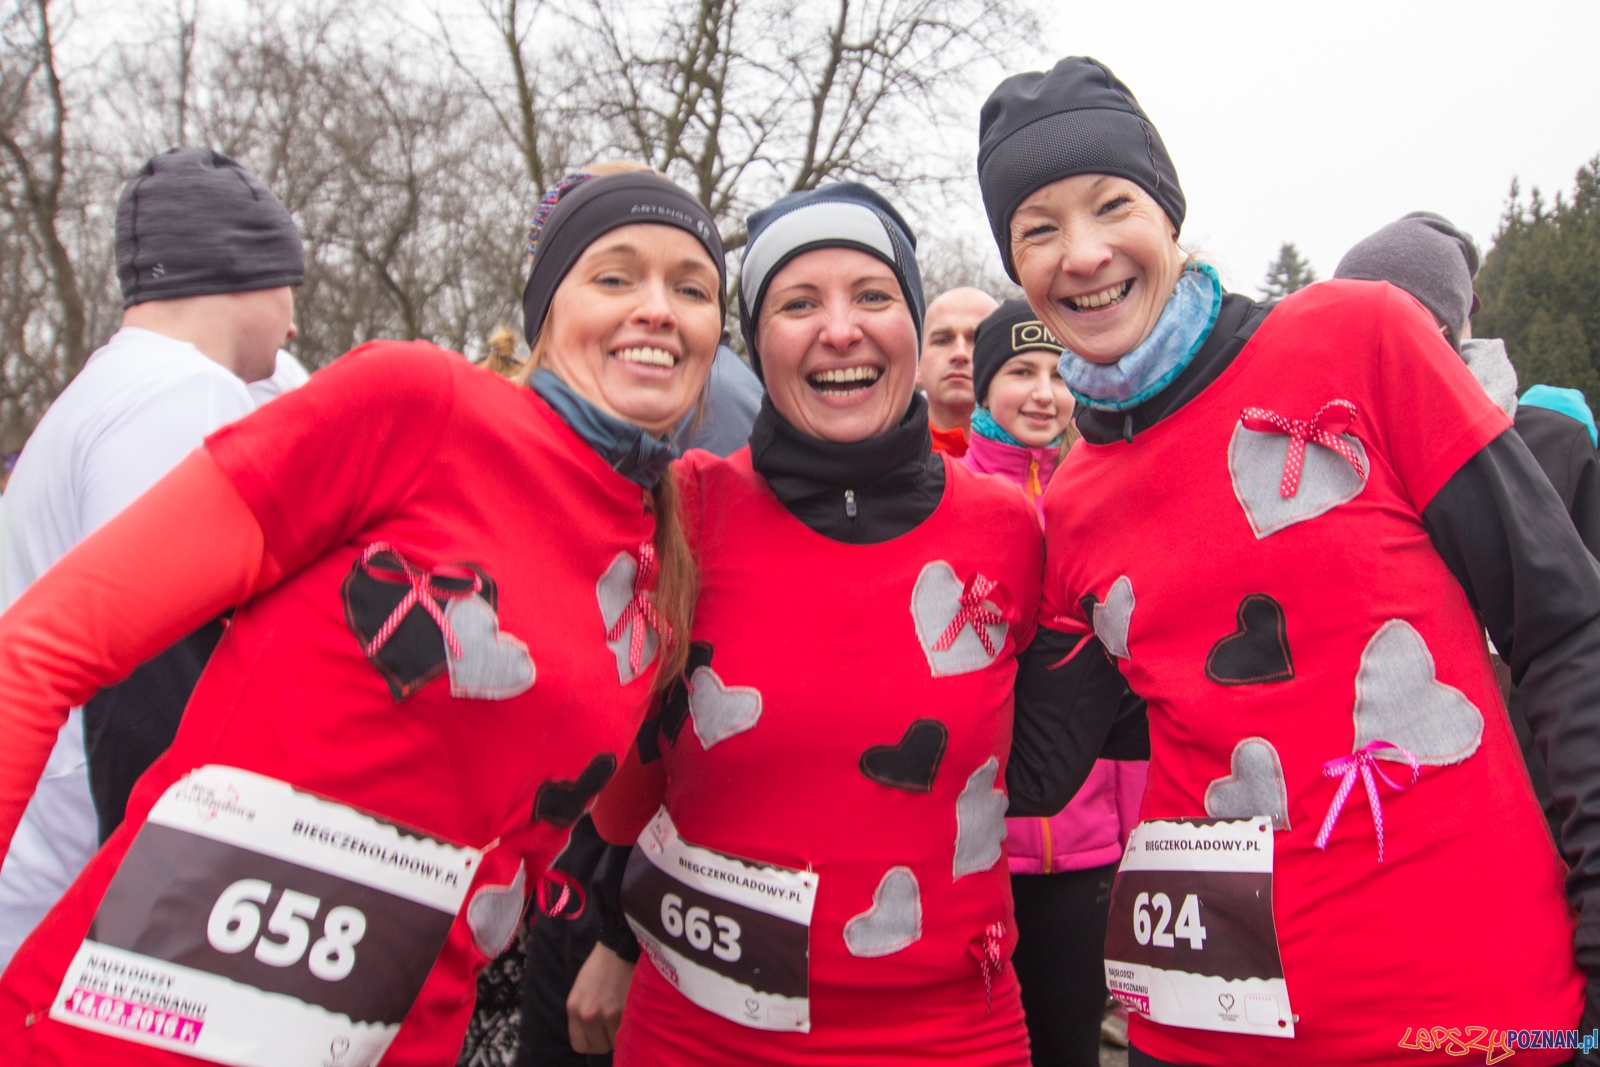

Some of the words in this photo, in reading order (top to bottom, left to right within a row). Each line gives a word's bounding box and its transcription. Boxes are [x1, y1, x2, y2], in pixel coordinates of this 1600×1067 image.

[631, 204, 693, 224] ARTENGO
[292, 819, 460, 888] BIEGCZEKOLADOWY.PL
[1145, 839, 1261, 852] BIEGCZEKOLADOWY.PL
[678, 856, 803, 904] BIEGCZEKOLADOWY.PL
[206, 878, 367, 982] 658
[660, 893, 742, 963] 663
[1133, 892, 1207, 950] 624
[112, 981, 128, 999] W
[131, 987, 208, 1018] POZNANIU
[1123, 983, 1149, 994] POZNANIU
